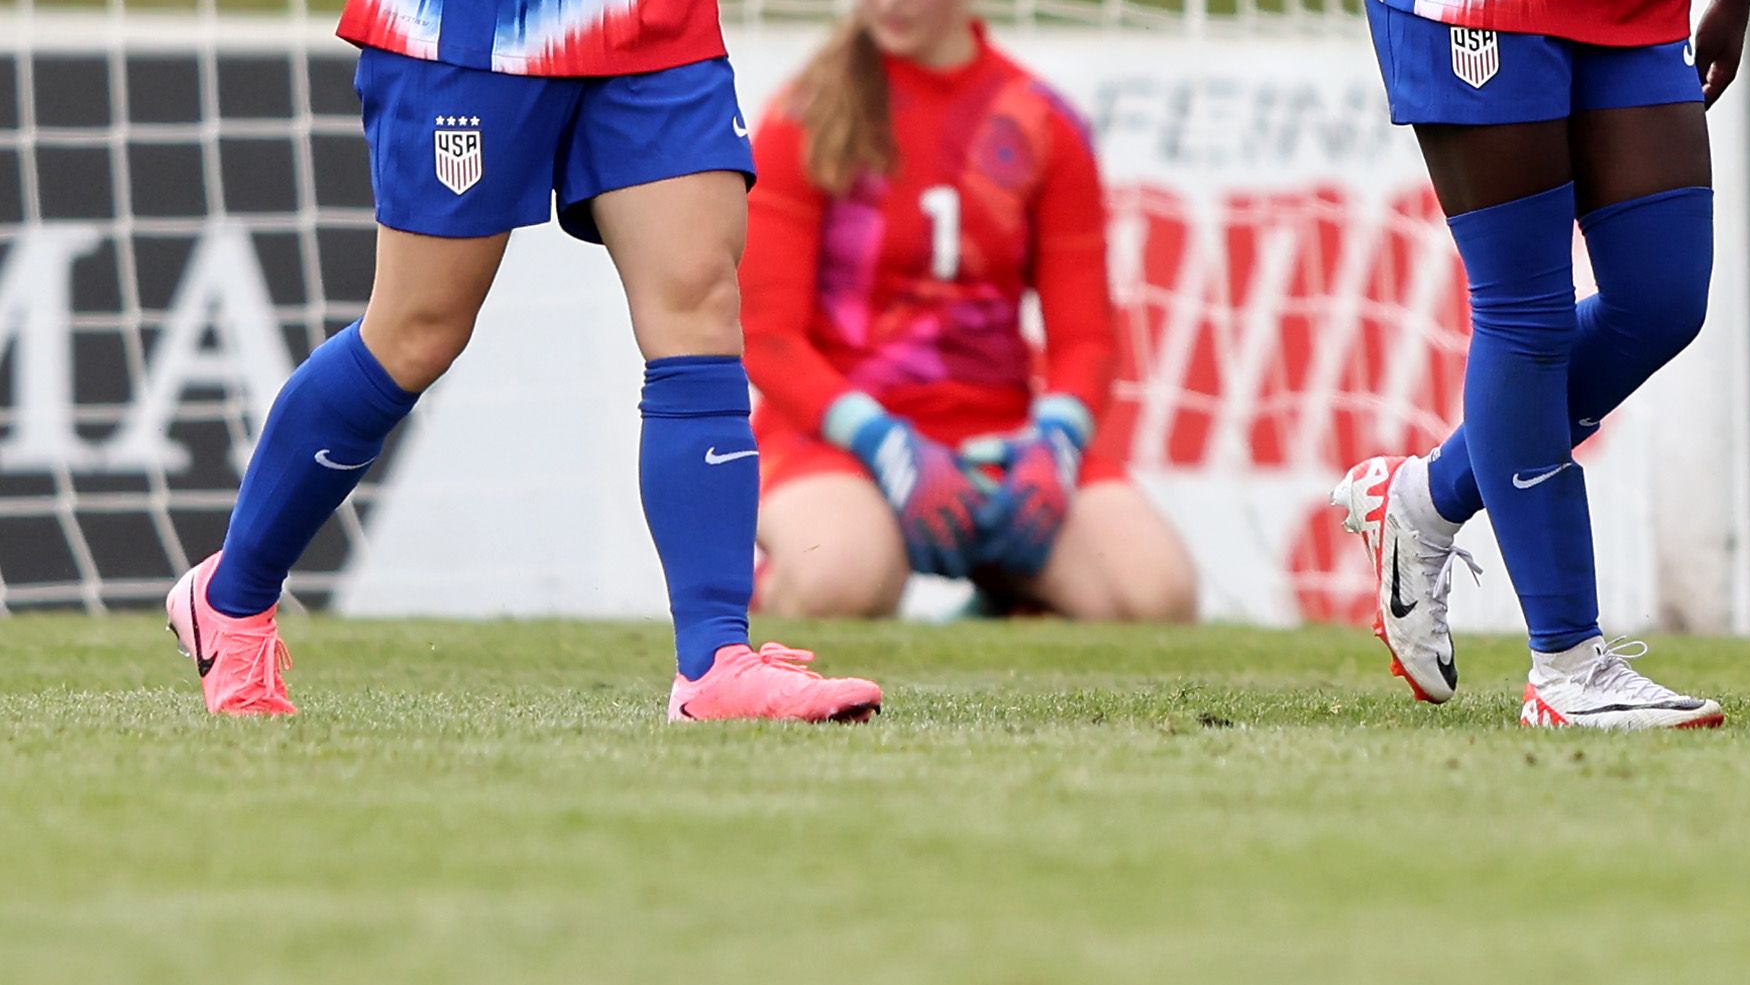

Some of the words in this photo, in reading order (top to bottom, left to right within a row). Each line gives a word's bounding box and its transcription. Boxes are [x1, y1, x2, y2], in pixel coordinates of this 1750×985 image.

[1454, 28, 1495, 52] USA
[438, 133, 478, 158] USA
[918, 184, 962, 281] 1
